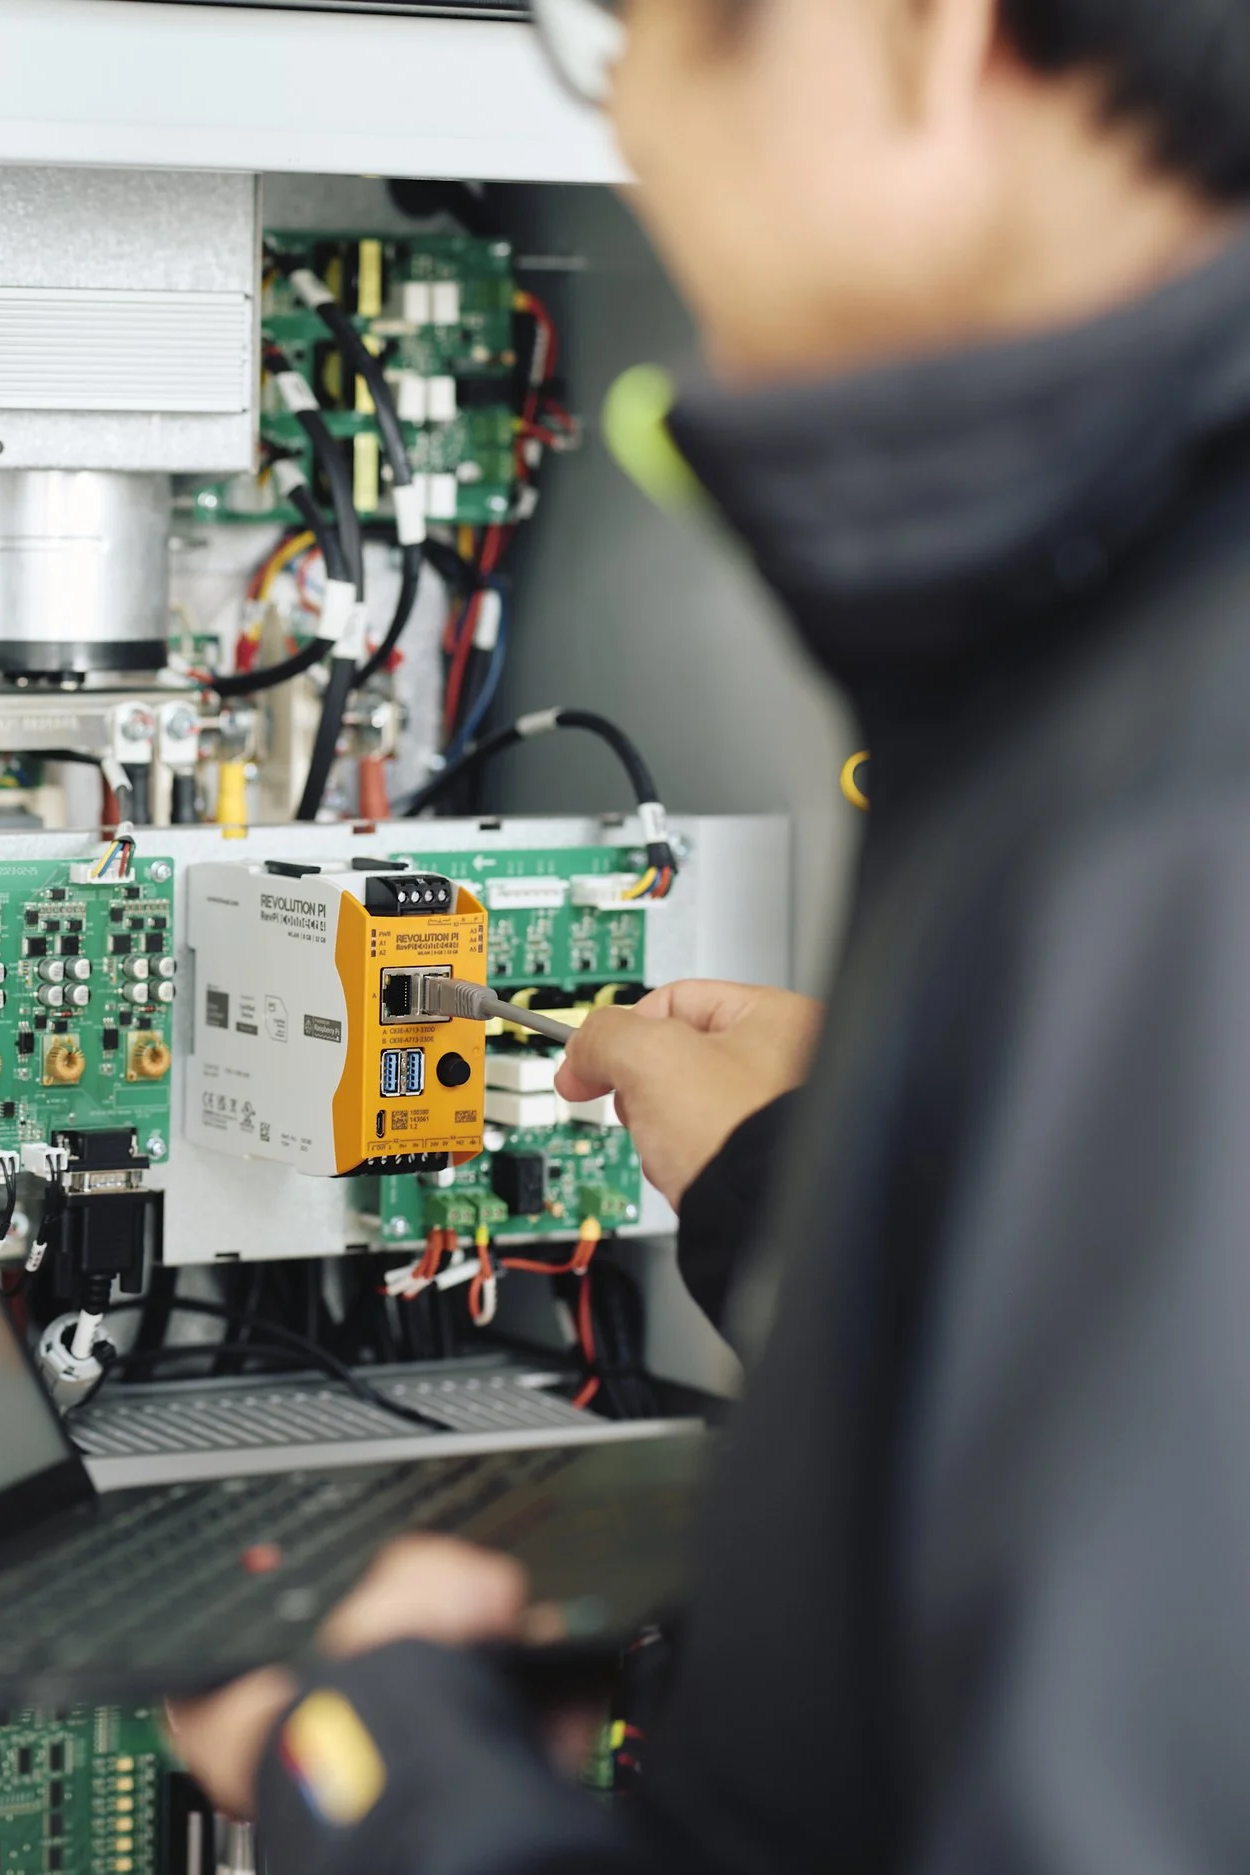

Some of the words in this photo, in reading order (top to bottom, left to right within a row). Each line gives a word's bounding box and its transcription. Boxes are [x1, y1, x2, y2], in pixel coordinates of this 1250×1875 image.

[261, 893, 316, 916] REVOLUTION
[317, 903, 326, 919] PI
[396, 933, 449, 943] REVOLUTION
[451, 932, 459, 940] PI
